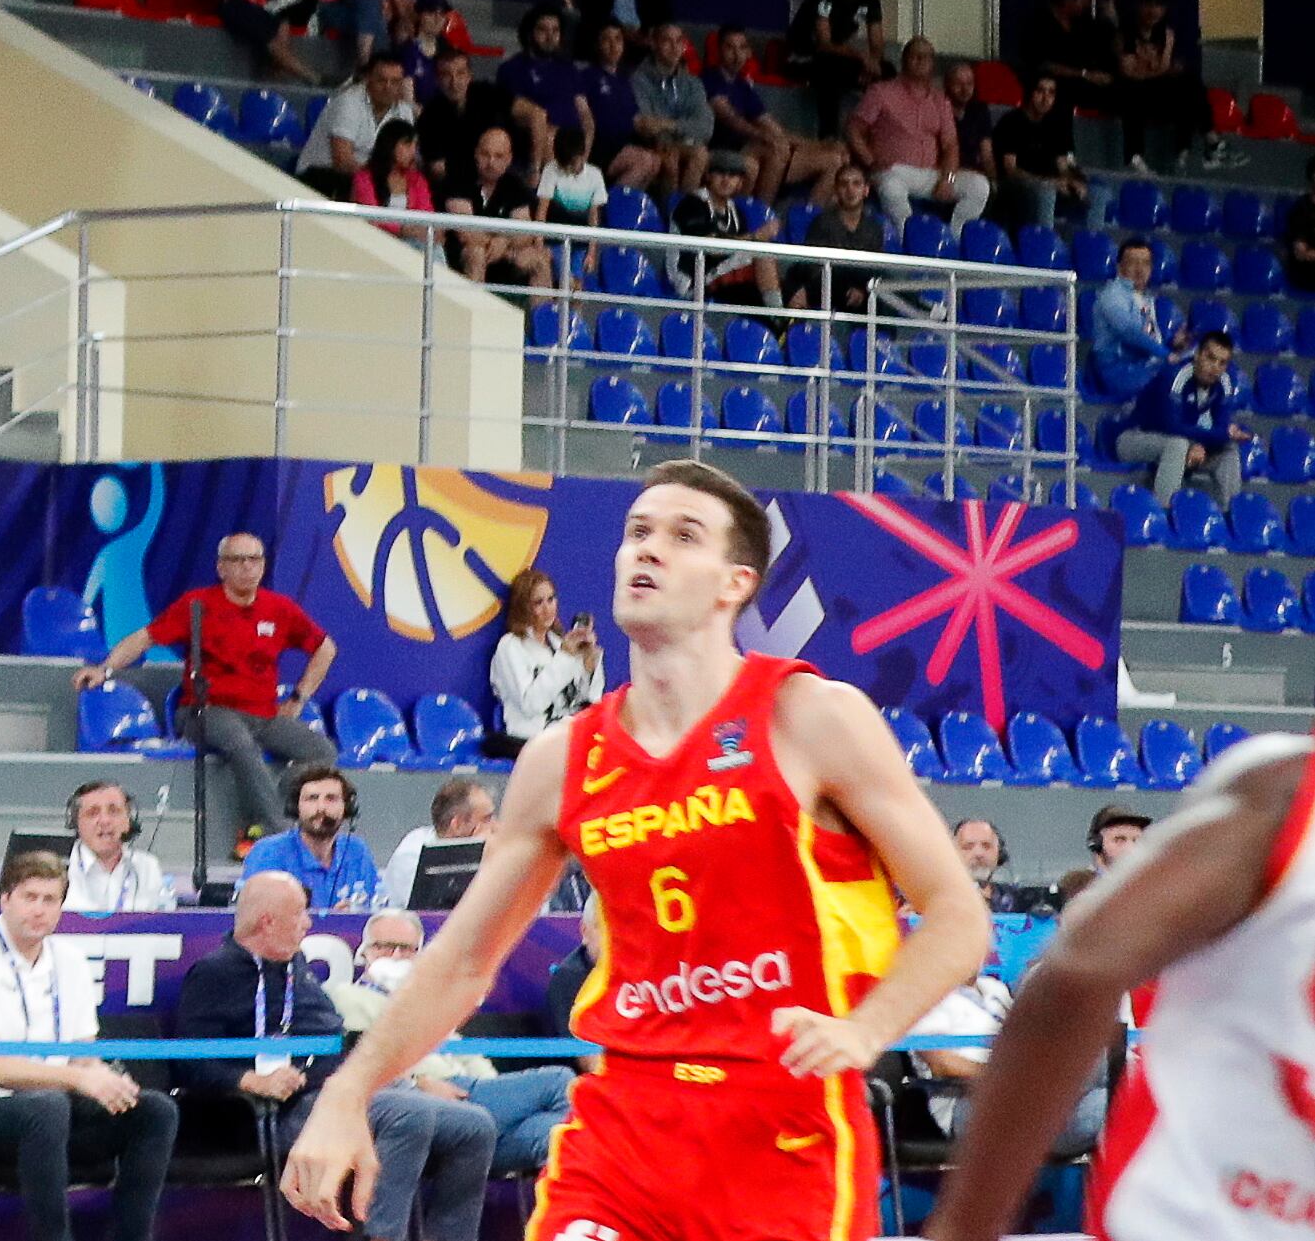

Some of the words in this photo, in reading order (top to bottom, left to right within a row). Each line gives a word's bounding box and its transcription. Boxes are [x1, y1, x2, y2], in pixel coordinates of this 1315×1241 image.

[579, 783, 758, 857] ESPAÑA
[649, 864, 698, 934] 6
[615, 949, 794, 1020] endesa
[672, 1061, 728, 1086] ESP
